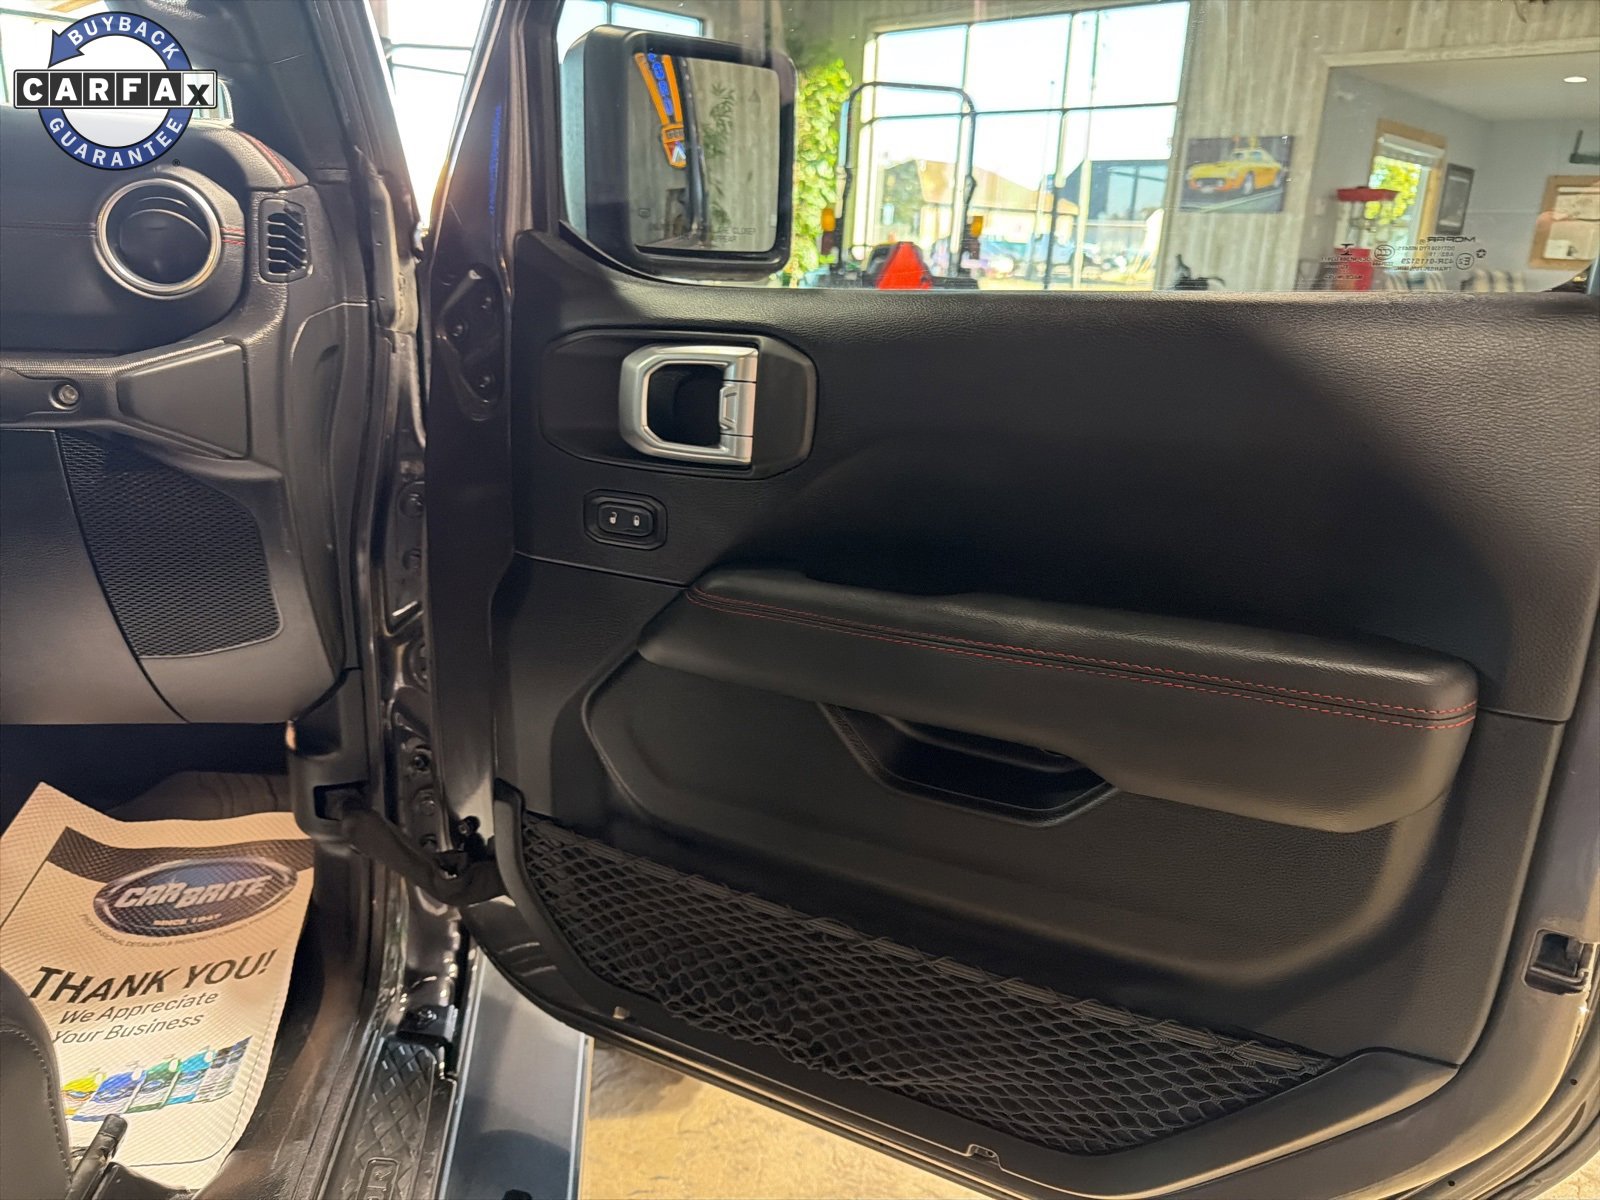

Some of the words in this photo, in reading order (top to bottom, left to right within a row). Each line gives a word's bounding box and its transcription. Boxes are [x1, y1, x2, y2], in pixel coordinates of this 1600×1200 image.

[29, 966, 180, 1004] THANK
[183, 948, 278, 989] YOU!
[59, 1010, 95, 1025] We
[95, 992, 219, 1023] Appreciate
[52, 1030, 103, 1044] Your
[103, 1013, 205, 1040] Business
